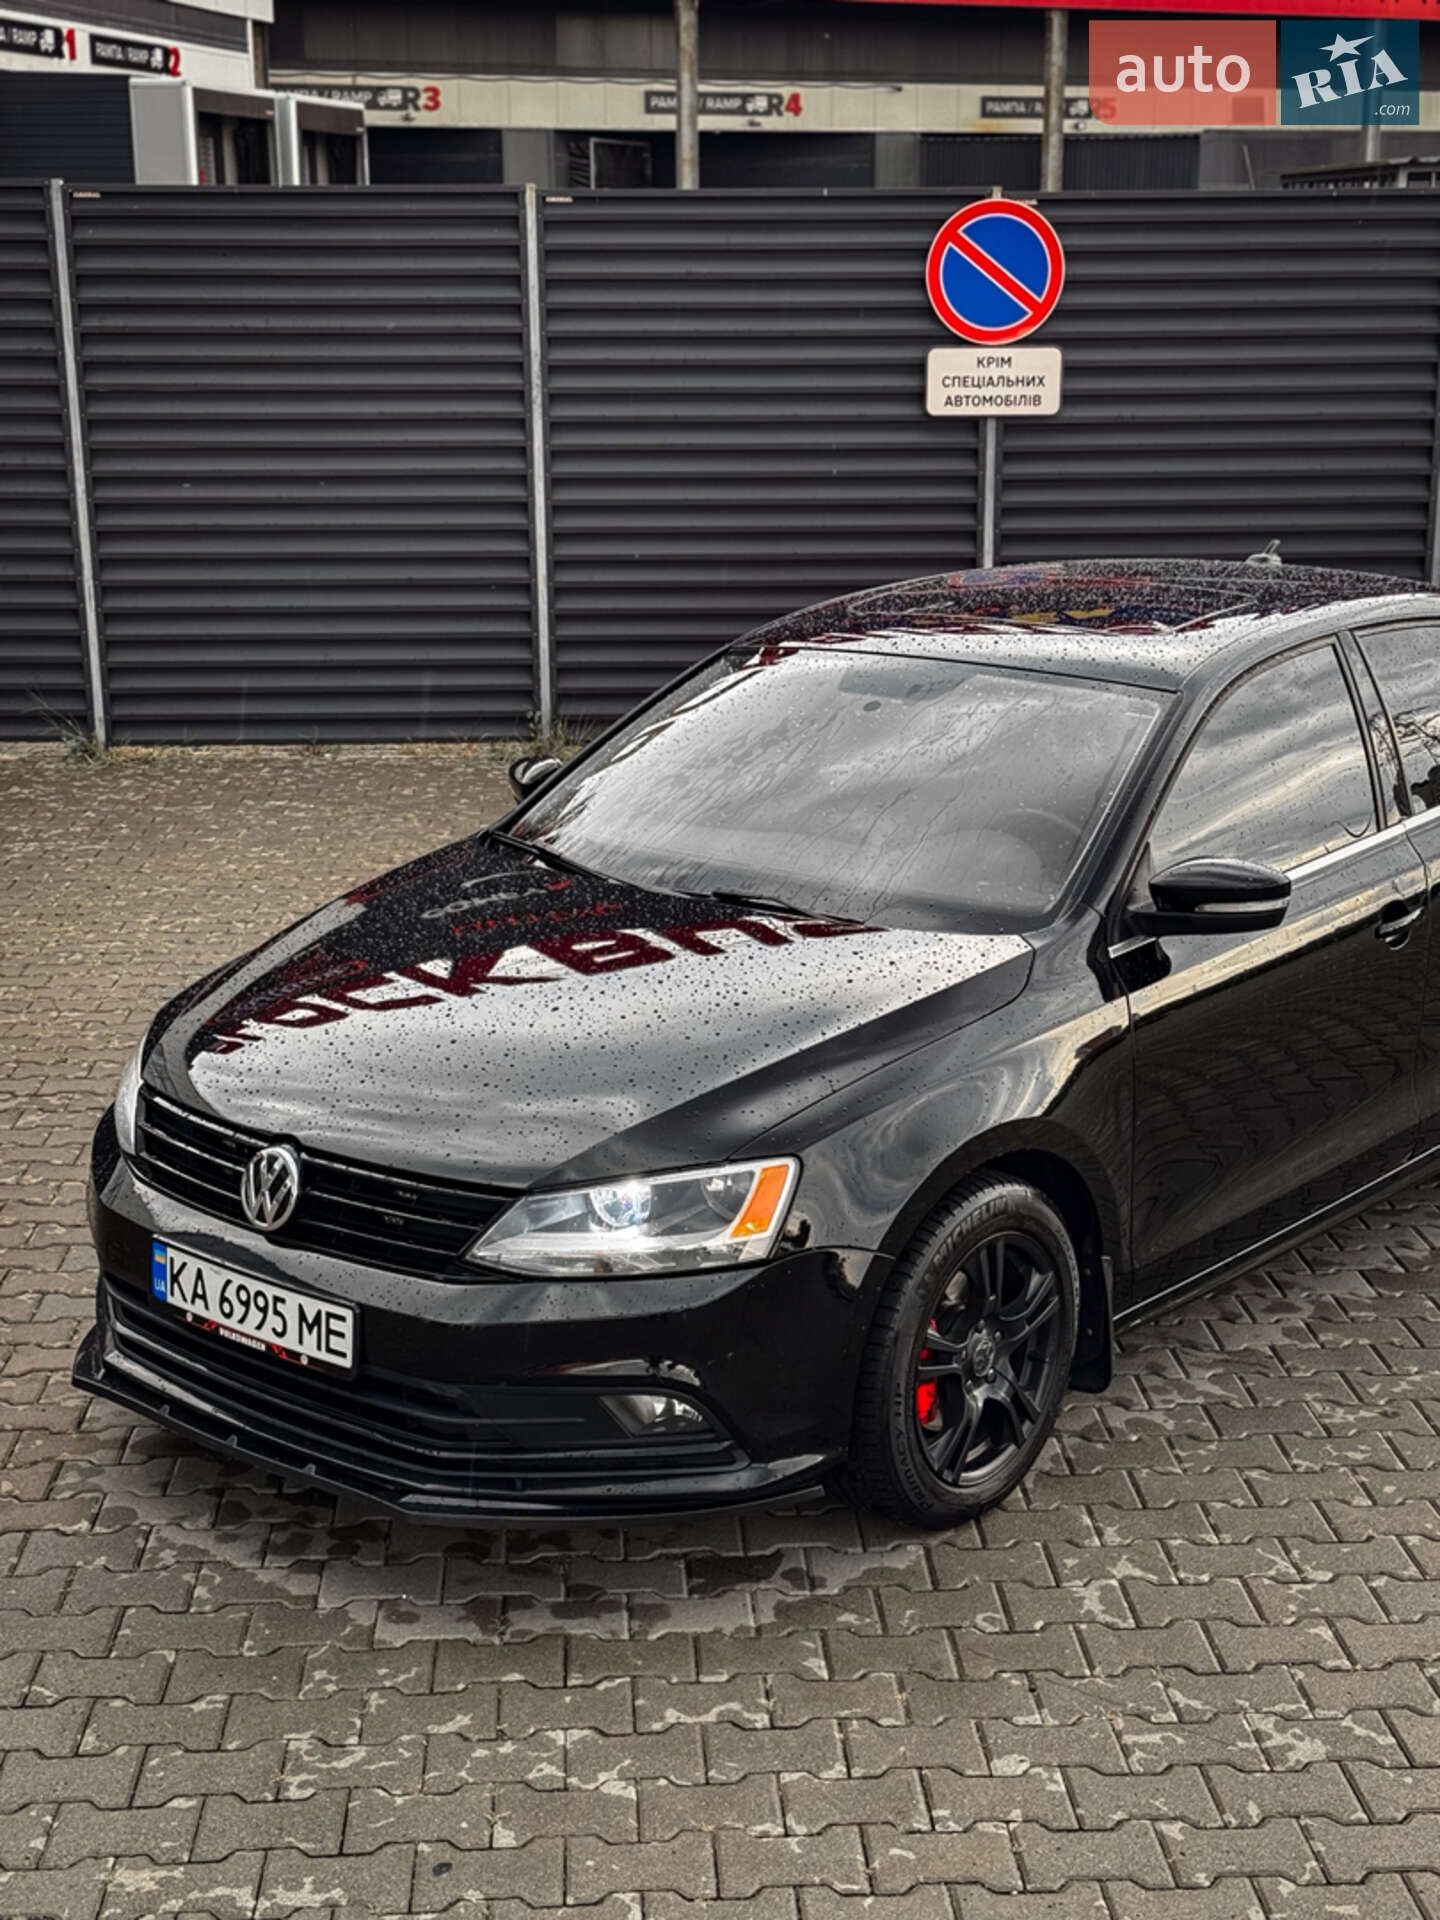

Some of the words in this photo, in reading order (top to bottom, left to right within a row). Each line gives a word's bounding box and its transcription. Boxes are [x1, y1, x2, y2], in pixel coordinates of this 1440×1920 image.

[706, 97, 743, 109] RAMP
[976, 356, 1012, 368] КРІМ
[942, 375, 1046, 389] СПЕЦІАЛЬНИХ
[944, 395, 1042, 407] АВТОМОБІЛІВ
[154, 1277, 166, 1293] UA
[170, 1256, 209, 1311] KA
[219, 1278, 287, 1338] 6995
[298, 1302, 347, 1359] ME
